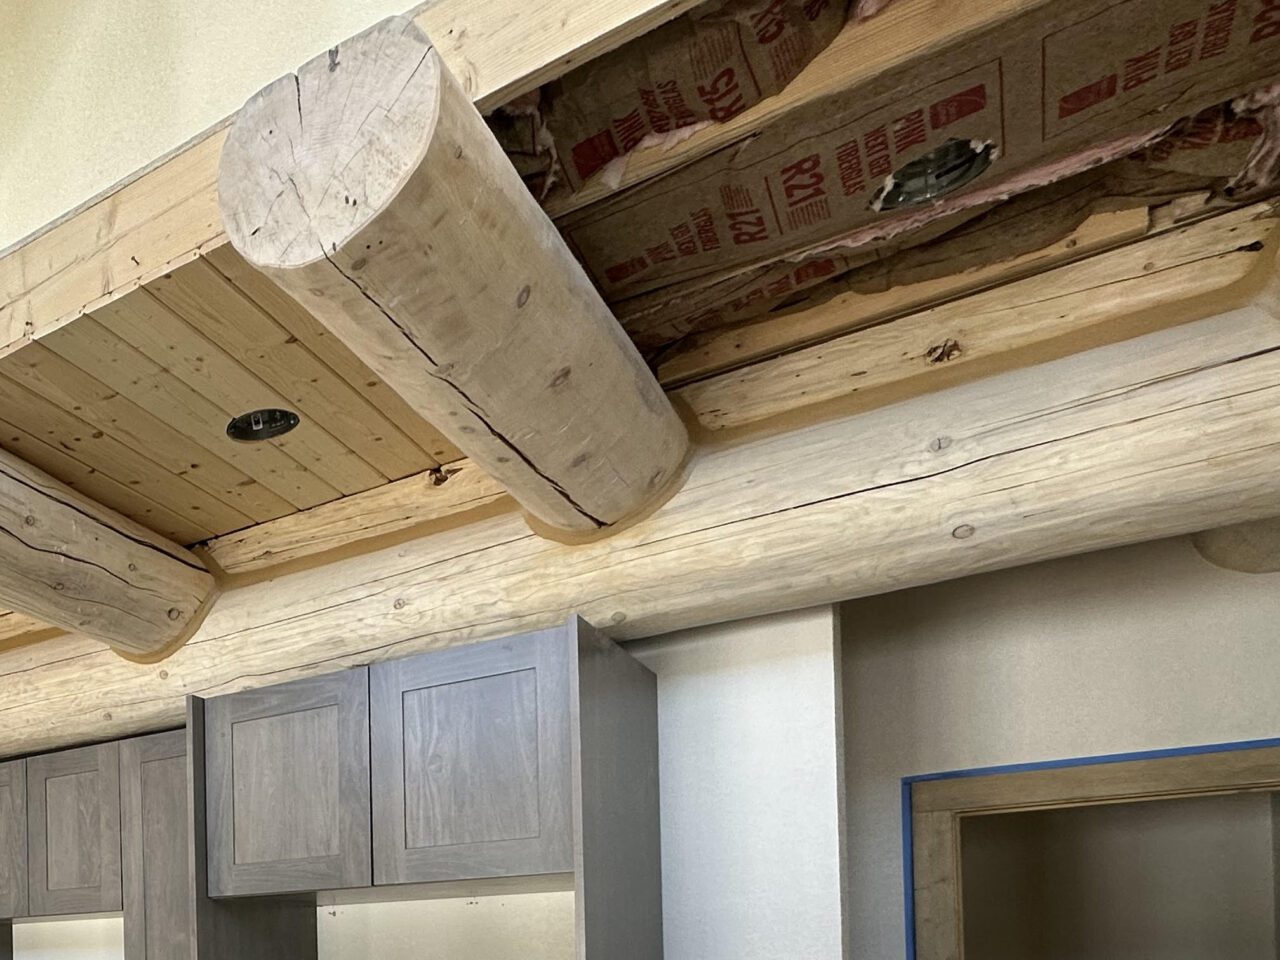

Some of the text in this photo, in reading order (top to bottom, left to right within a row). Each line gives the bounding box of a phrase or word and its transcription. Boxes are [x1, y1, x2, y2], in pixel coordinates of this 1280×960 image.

[1122, 45, 1162, 92] PINK
[697, 67, 746, 124] R15
[612, 108, 647, 151] PINK
[863, 124, 892, 180] NEXT GEN
[891, 109, 927, 154] PINK
[780, 153, 827, 208] R21
[835, 138, 866, 197] FIBERGLAS
[726, 208, 768, 245] R21
